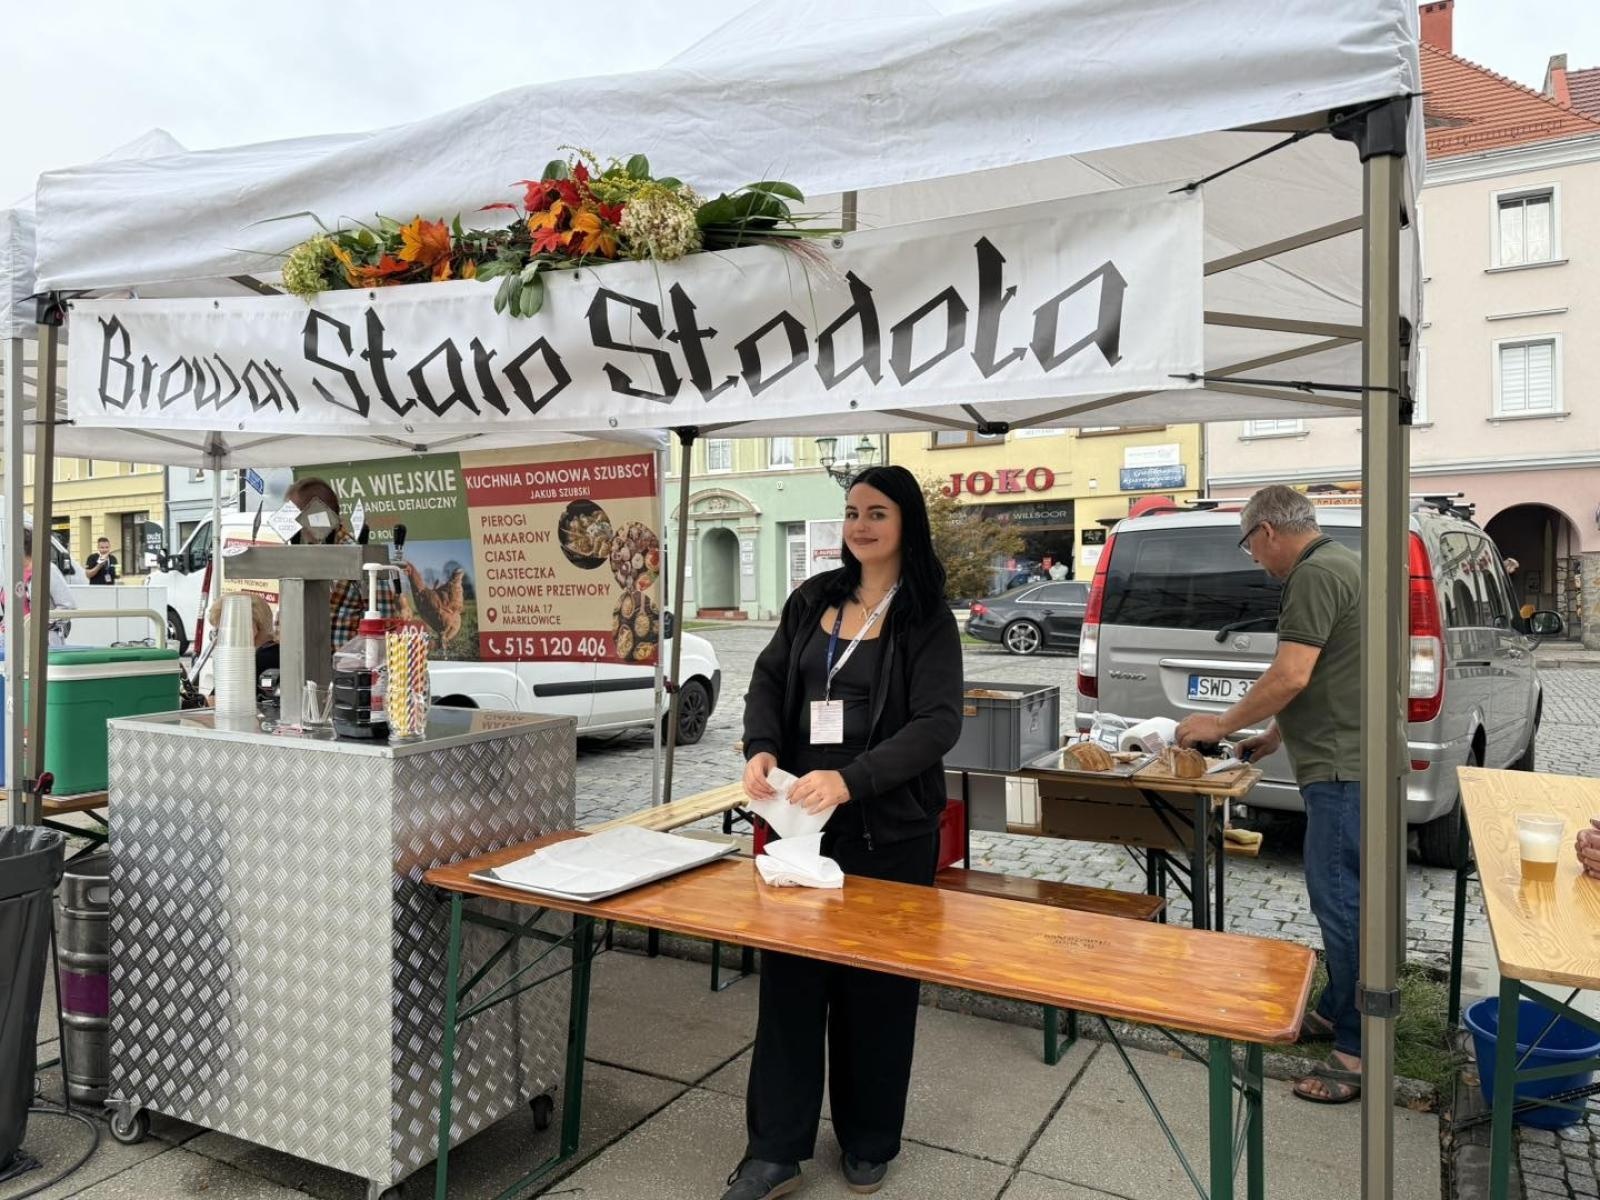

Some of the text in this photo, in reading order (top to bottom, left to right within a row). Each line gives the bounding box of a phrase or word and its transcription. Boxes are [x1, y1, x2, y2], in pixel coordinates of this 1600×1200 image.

[98, 235, 1129, 418] Browar Staro Stodoła
[368, 469, 457, 497] WIEJSKIE
[465, 462, 650, 489] KUCHNIA DOMOWA SZUBSCY
[943, 466, 1055, 498] JOKO
[530, 486, 591, 500] JAKUB SZUBSKI
[364, 499, 396, 513] ANDEL
[399, 496, 457, 511] DETALICZNY
[481, 513, 527, 528] PIEROGI
[483, 531, 551, 545] MAKARONY
[485, 549, 526, 563] CIASTA
[486, 567, 556, 580] CIASTECZKA
[489, 583, 611, 598] DOMOWE PRZETWORY
[502, 604, 553, 614] UL. ZANA 17
[502, 615, 561, 626] MARKLOWICE
[505, 637, 606, 656] 515 120 406
[1199, 678, 1232, 697] SWD
